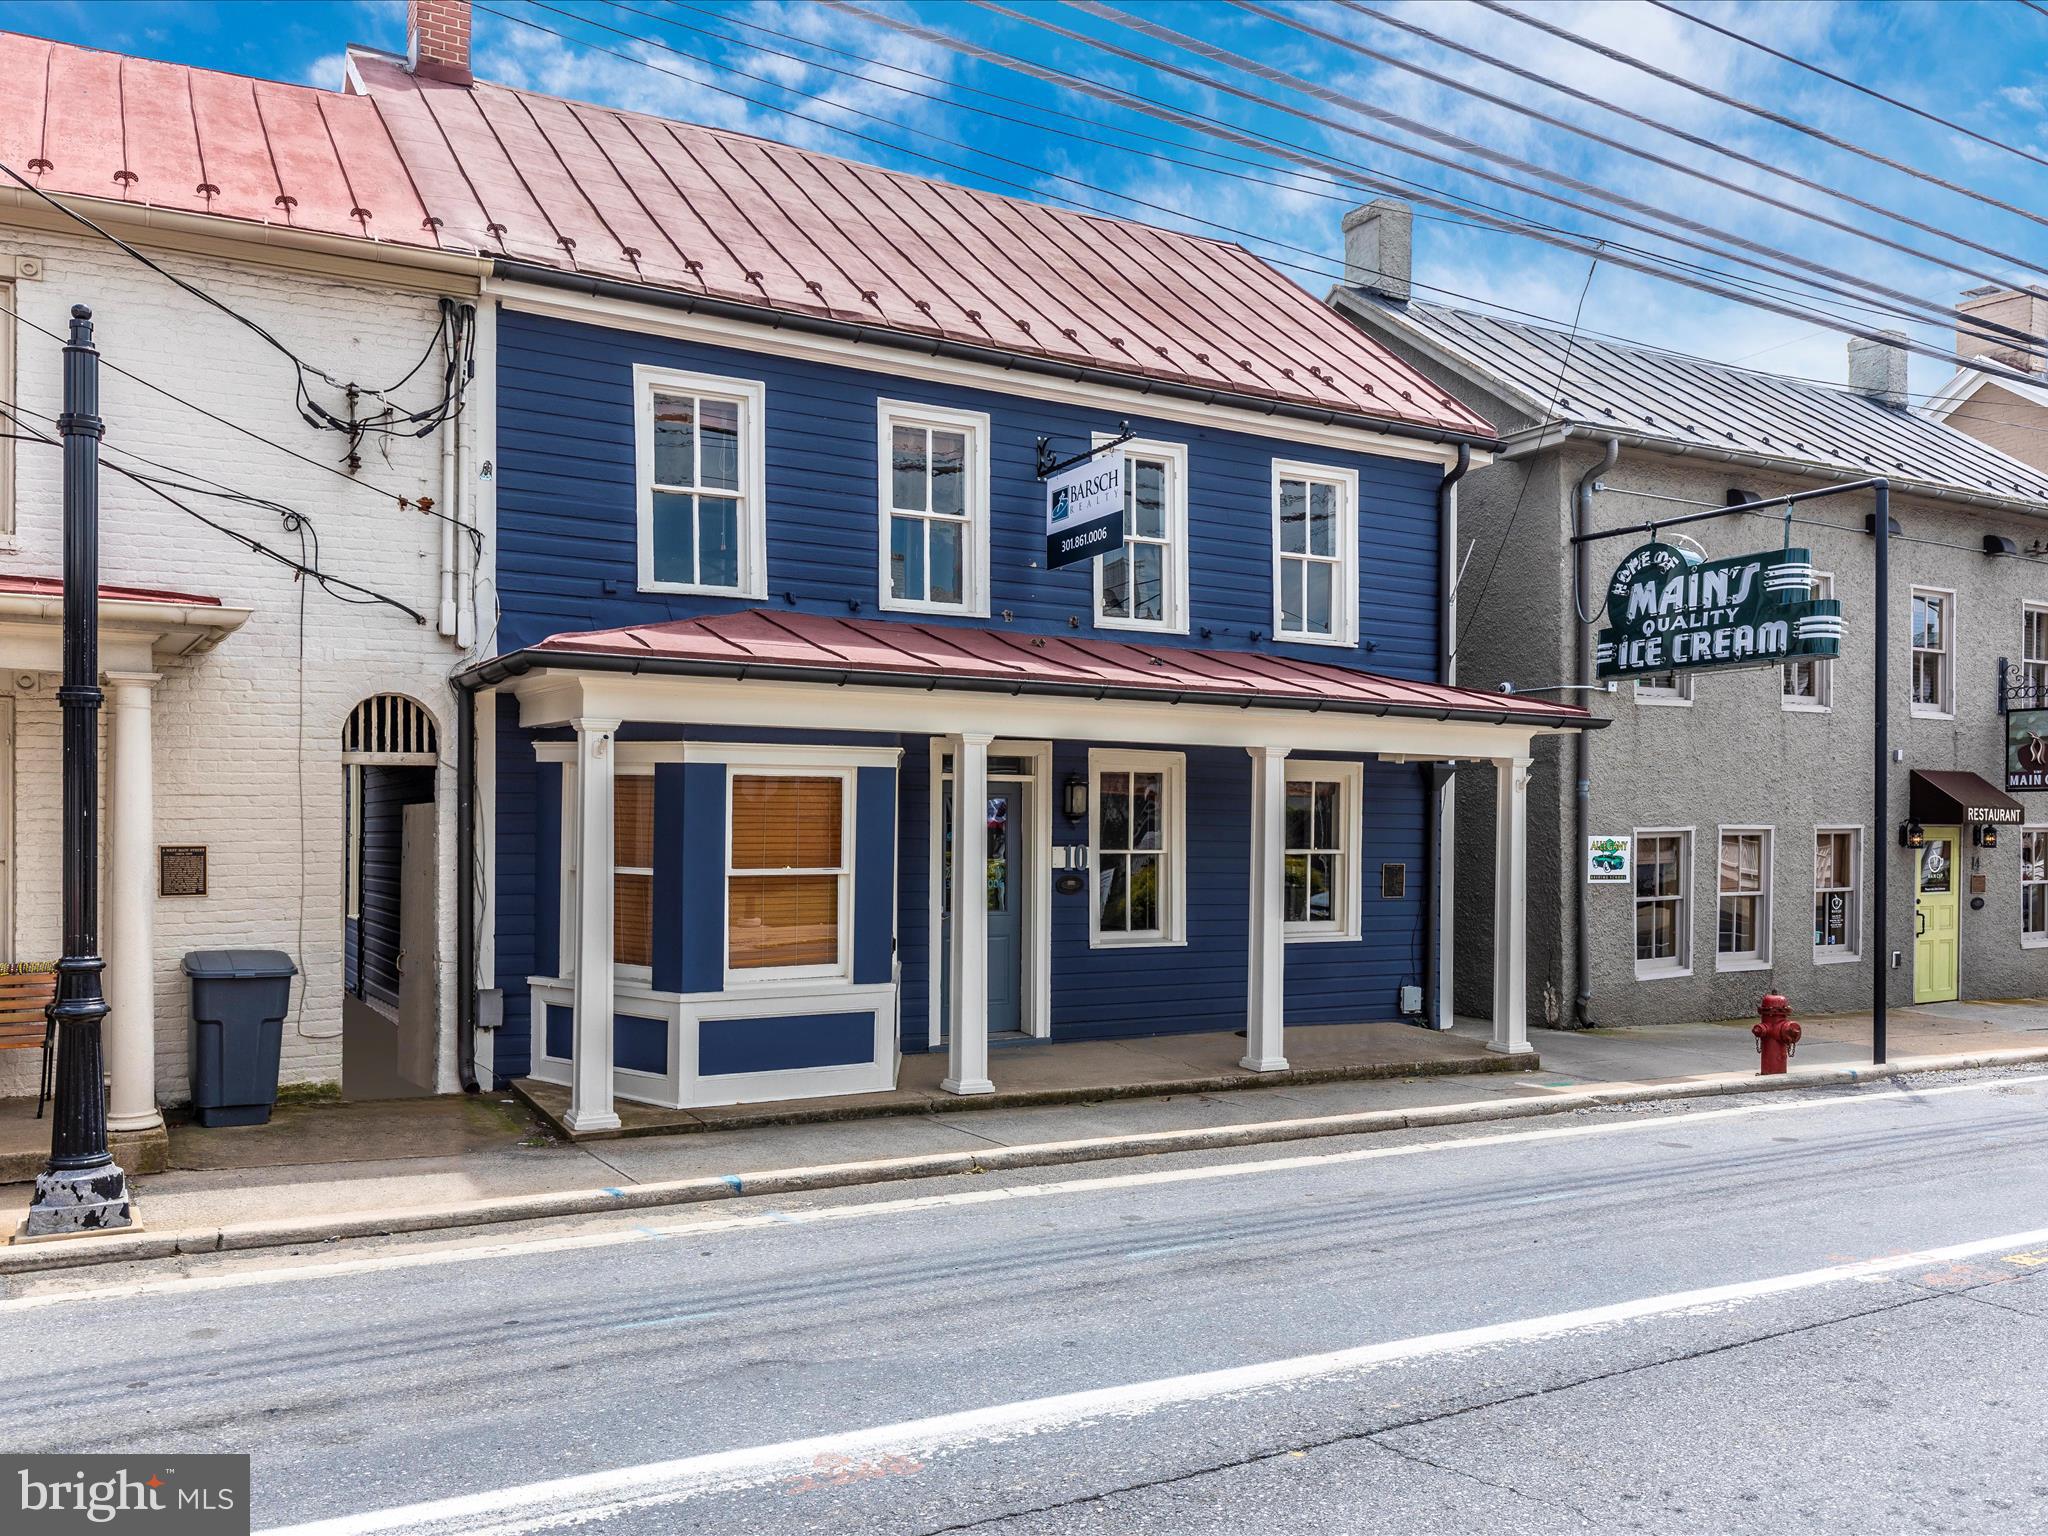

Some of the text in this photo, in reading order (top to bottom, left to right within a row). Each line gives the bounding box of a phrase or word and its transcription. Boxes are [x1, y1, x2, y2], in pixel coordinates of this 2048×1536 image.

[1070, 469, 1119, 503] BARSCH
[1069, 489, 1119, 515] REALTY
[1061, 526, 1107, 552] 301.861.0006
[1611, 551, 1651, 596] HOME
[1628, 562, 1760, 621] MAIN'S
[1642, 607, 1740, 637] QUALITY
[1618, 619, 1789, 670] ICE CREAM
[2010, 775, 2042, 786] MAIN
[1968, 807, 2021, 822] RESTAURANT
[1063, 844, 1088, 871] 10
